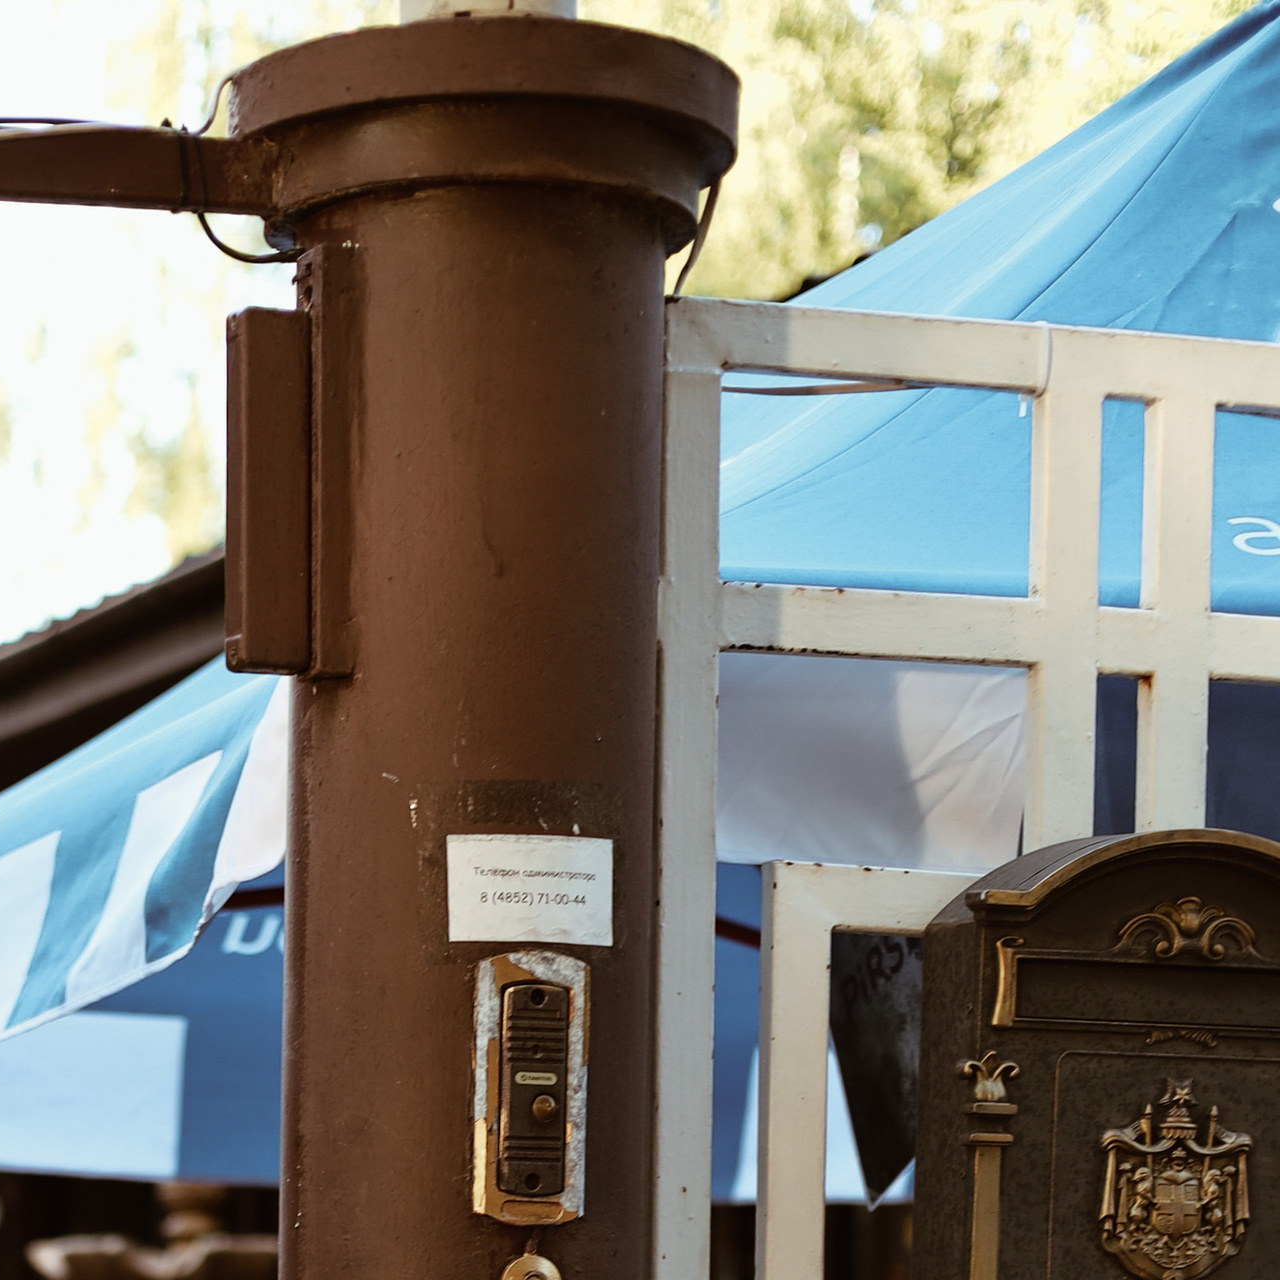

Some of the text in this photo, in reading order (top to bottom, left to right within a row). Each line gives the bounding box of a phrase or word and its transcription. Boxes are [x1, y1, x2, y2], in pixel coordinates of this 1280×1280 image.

[473, 866, 521, 879] Телефон
[480, 891, 587, 906] 8 (4852) 71-00-44
